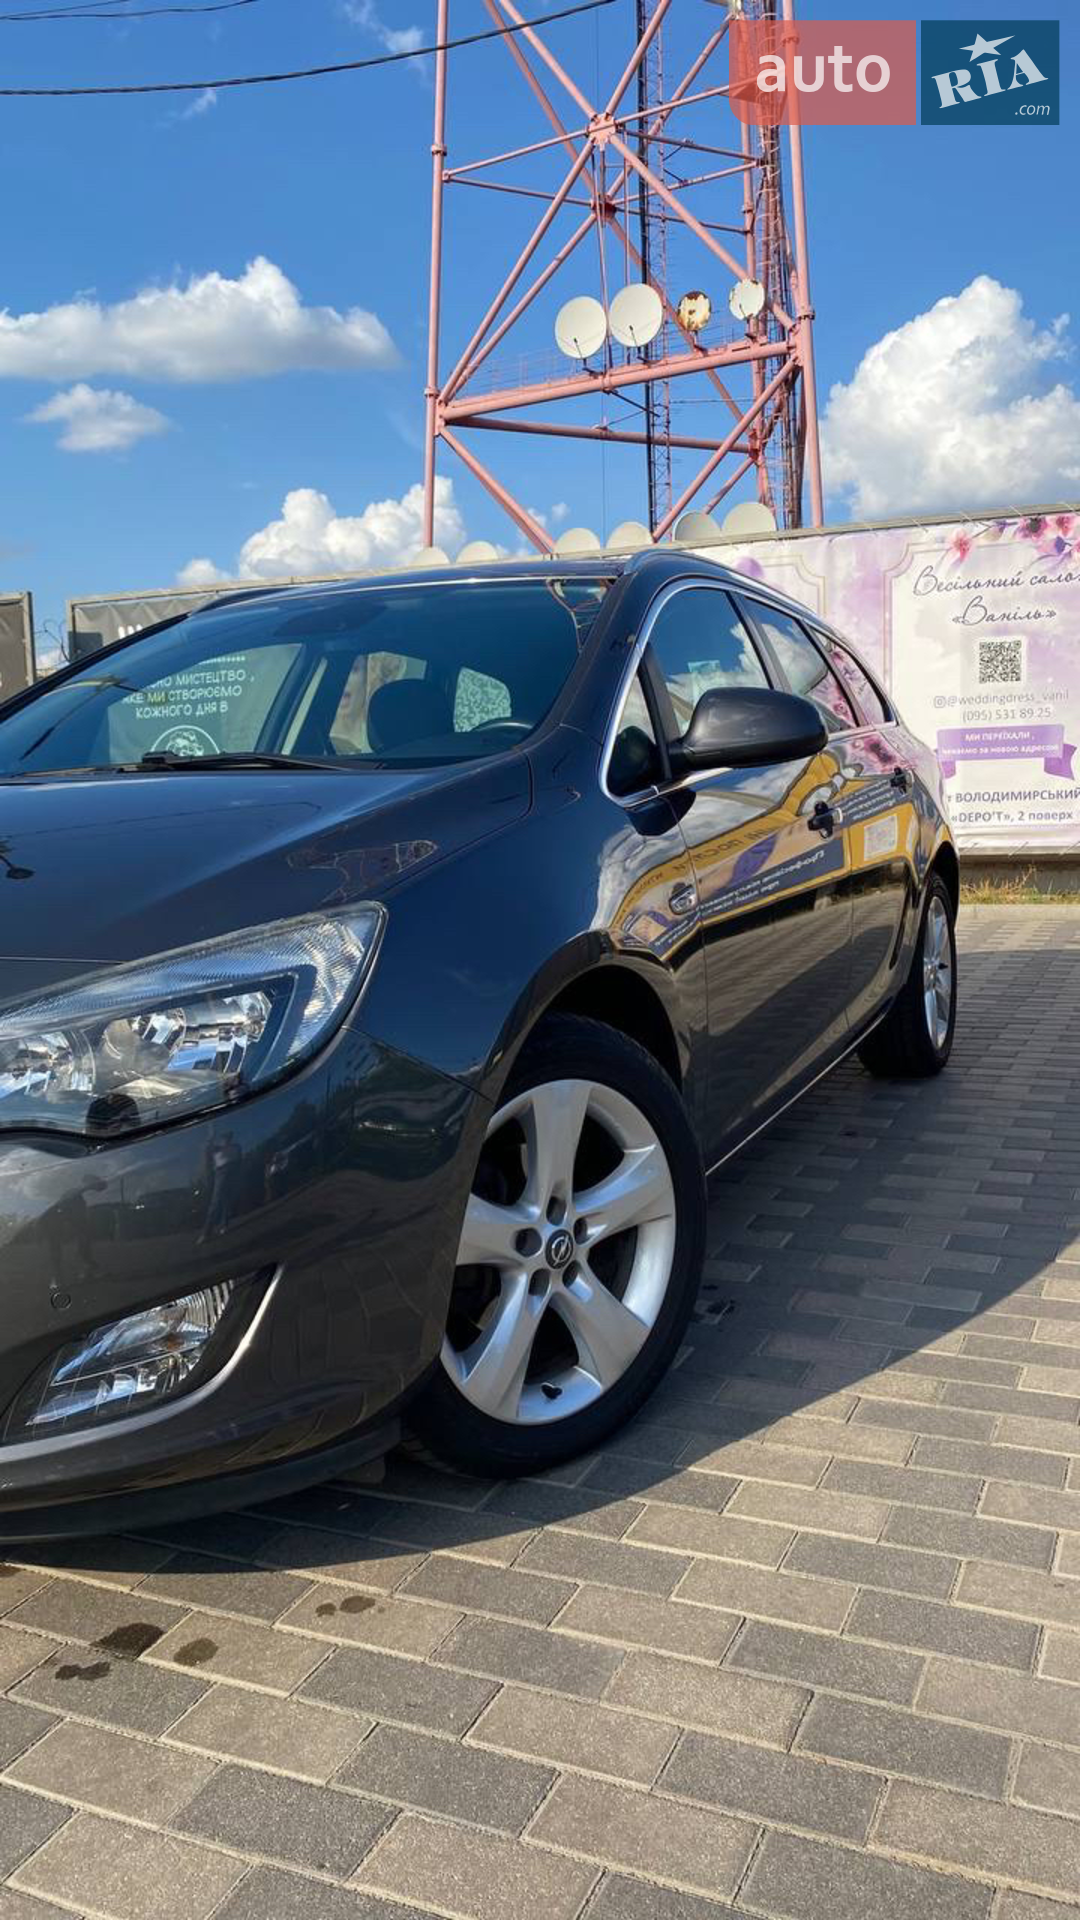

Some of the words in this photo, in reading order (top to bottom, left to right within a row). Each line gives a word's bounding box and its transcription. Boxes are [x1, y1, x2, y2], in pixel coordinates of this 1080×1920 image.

[913, 564, 1024, 596] Весільний
[1029, 571, 1080, 586] сало
[952, 595, 1057, 626] «Ваніль»
[147, 691, 166, 703] МИ
[135, 703, 192, 719] КОЖНОГО
[195, 701, 217, 717] ДНЯ
[962, 709, 992, 723] (095)
[995, 708, 1017, 720] 531
[1028, 811, 1074, 822] поверх
